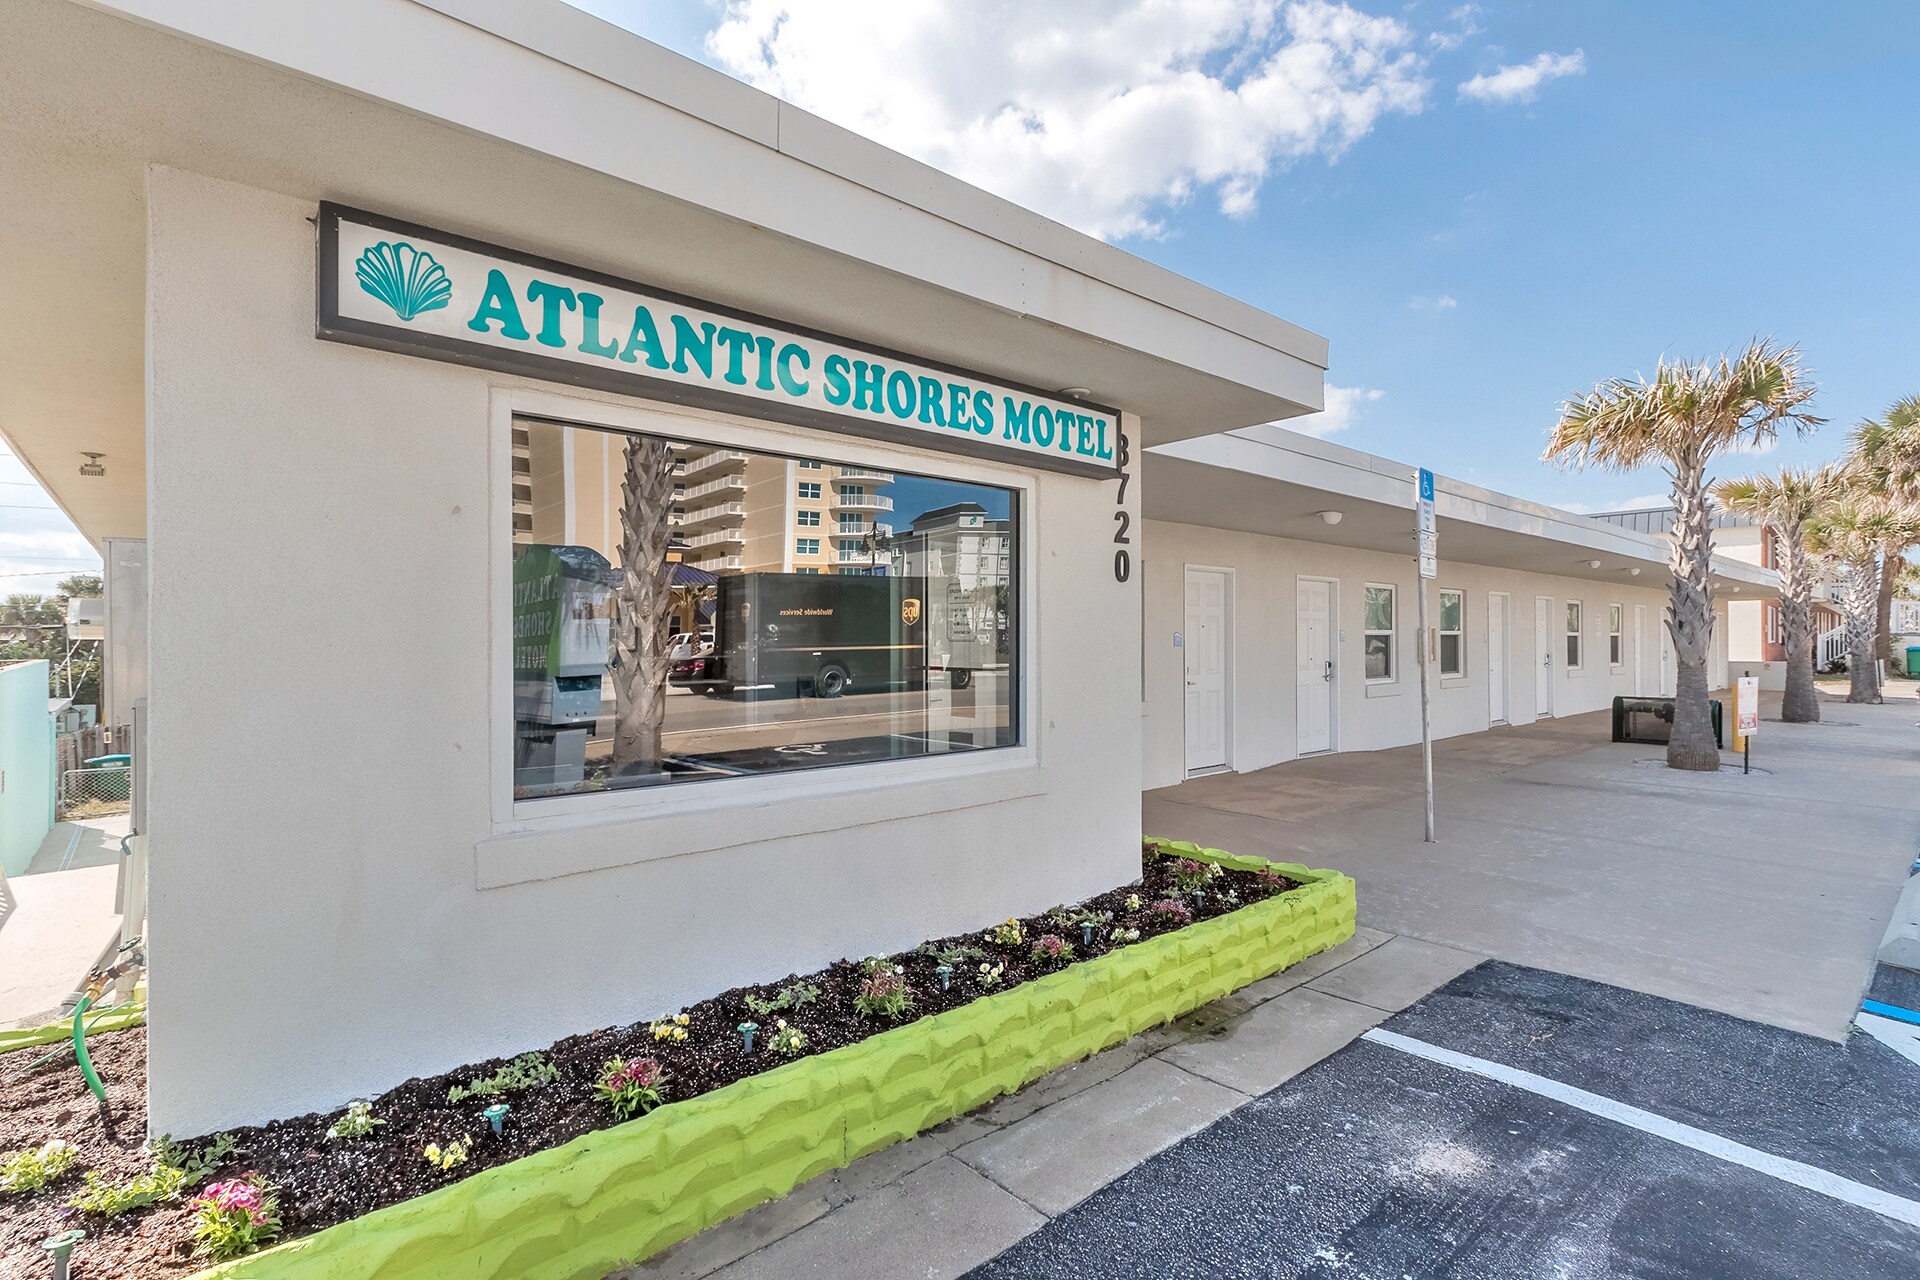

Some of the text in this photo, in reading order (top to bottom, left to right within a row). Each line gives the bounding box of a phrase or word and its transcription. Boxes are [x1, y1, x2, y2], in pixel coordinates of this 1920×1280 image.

[467, 269, 1113, 461] ATLANTIC SHORES MOTEL
